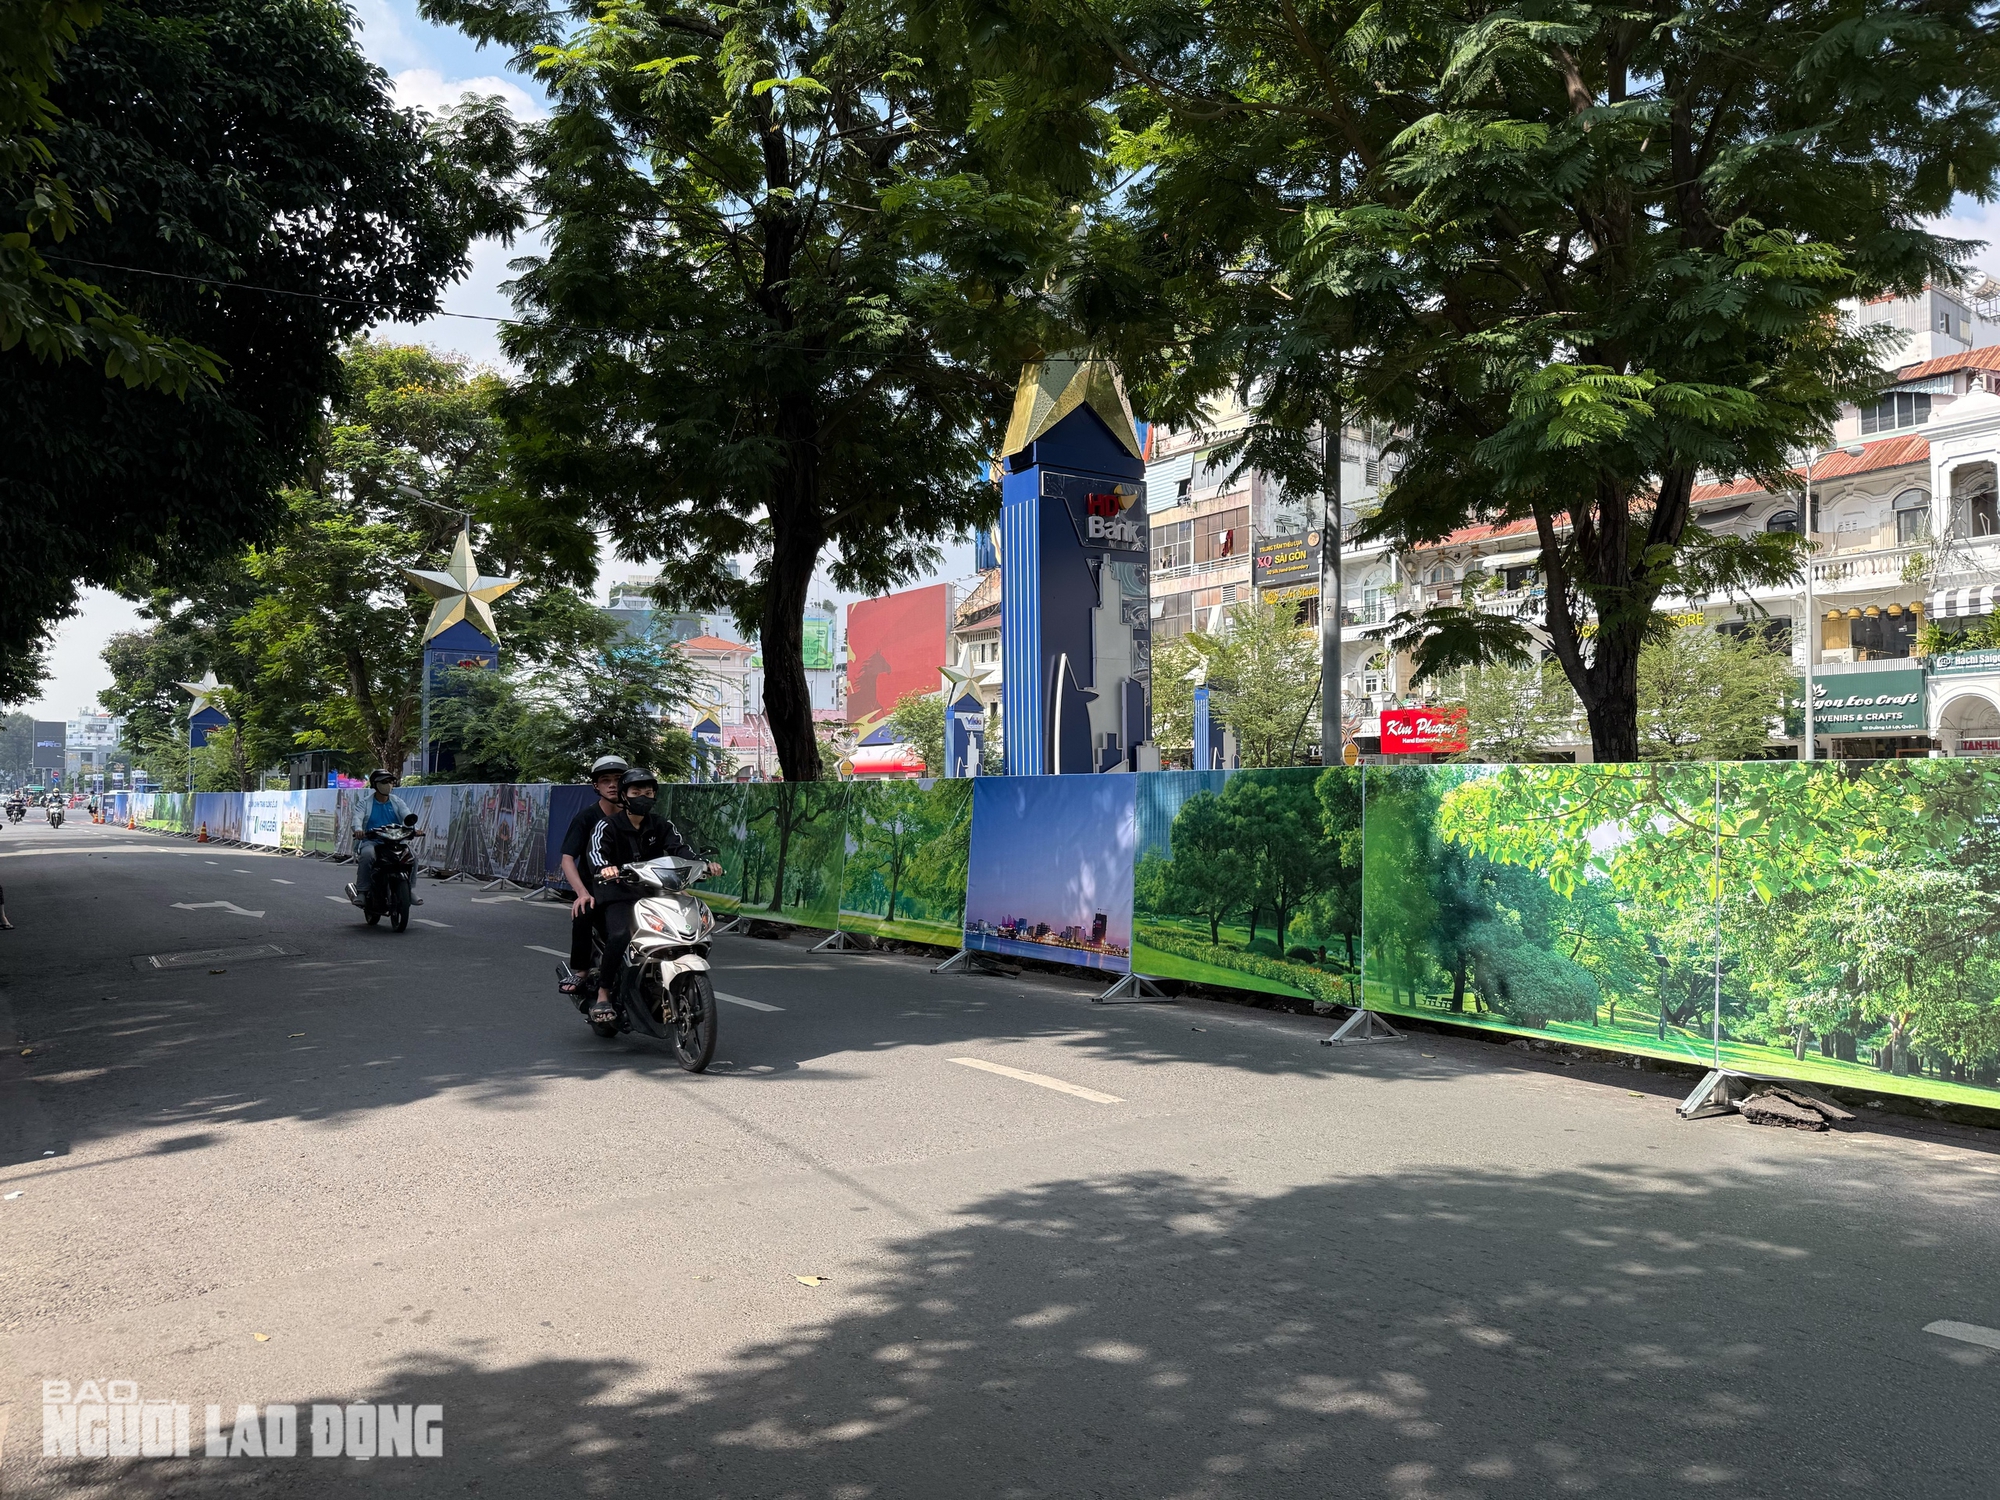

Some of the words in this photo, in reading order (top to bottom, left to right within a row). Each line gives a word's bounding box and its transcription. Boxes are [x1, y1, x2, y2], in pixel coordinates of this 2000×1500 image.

[1087, 493, 1119, 516] HD
[1088, 516, 1139, 542] Bank
[1256, 555, 1273, 568] XQ
[1845, 695, 1874, 707] Eco
[1875, 692, 1918, 706] Craft
[1865, 712, 1903, 720] CRAFTS
[1386, 719, 1413, 736] Kim
